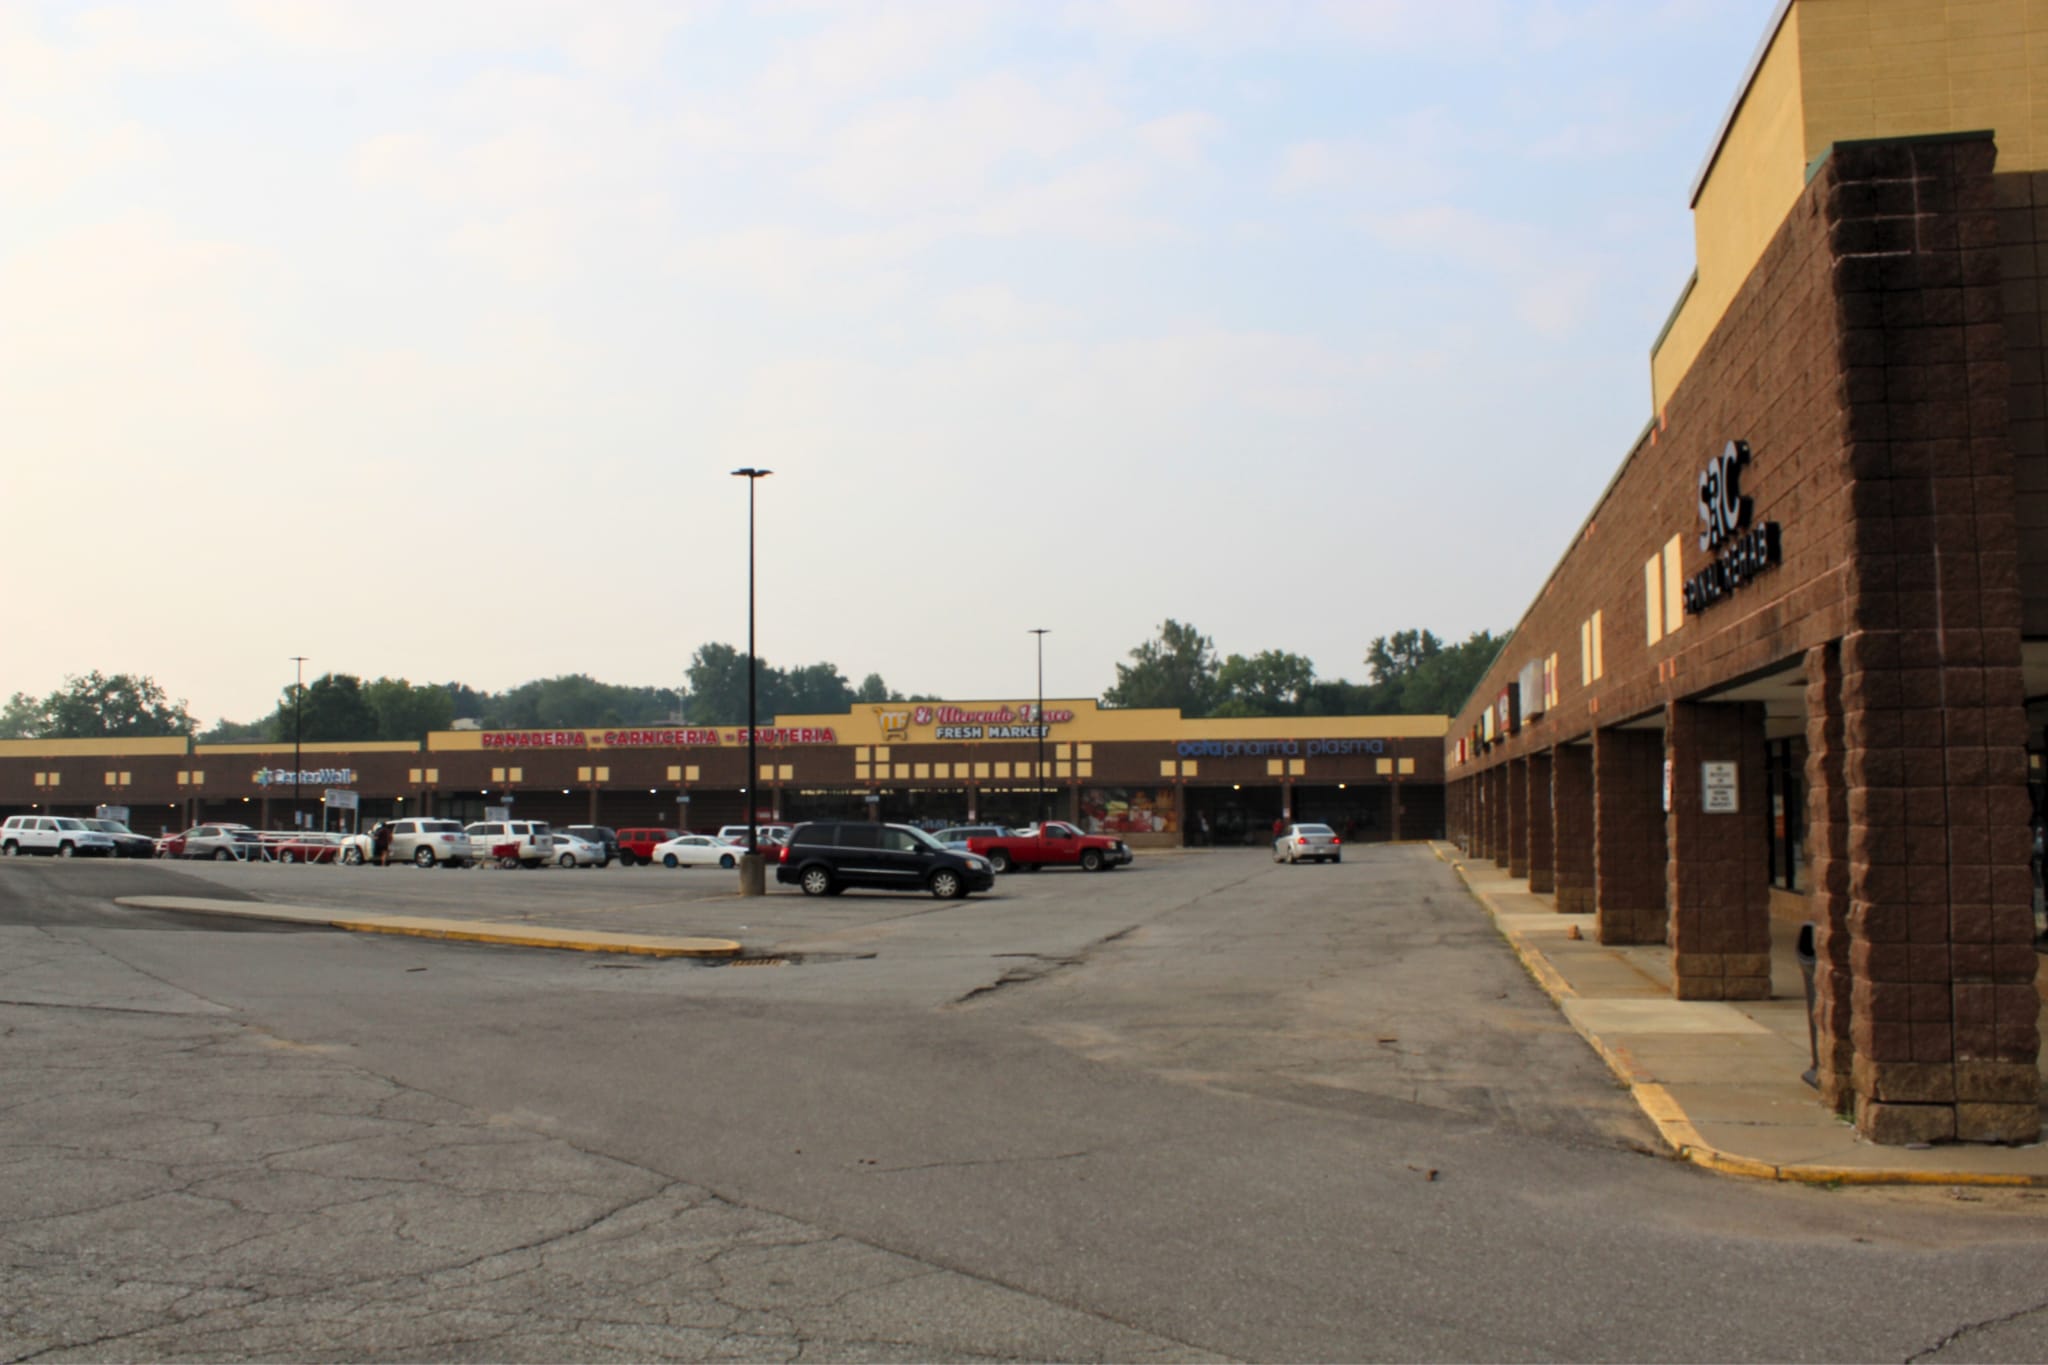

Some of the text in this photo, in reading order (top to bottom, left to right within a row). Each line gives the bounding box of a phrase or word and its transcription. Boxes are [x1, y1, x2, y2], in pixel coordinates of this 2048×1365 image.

[1698, 439, 1743, 553] SRC
[936, 705, 1016, 724] Mercado
[482, 731, 586, 746] PANADERIA
[604, 729, 718, 745] CARNICERIA
[737, 727, 836, 744] FRUTERIA
[935, 725, 1049, 739] FRESH MARKET
[1176, 738, 1383, 758] octapharma plasma
[275, 768, 351, 784] CenterWell
